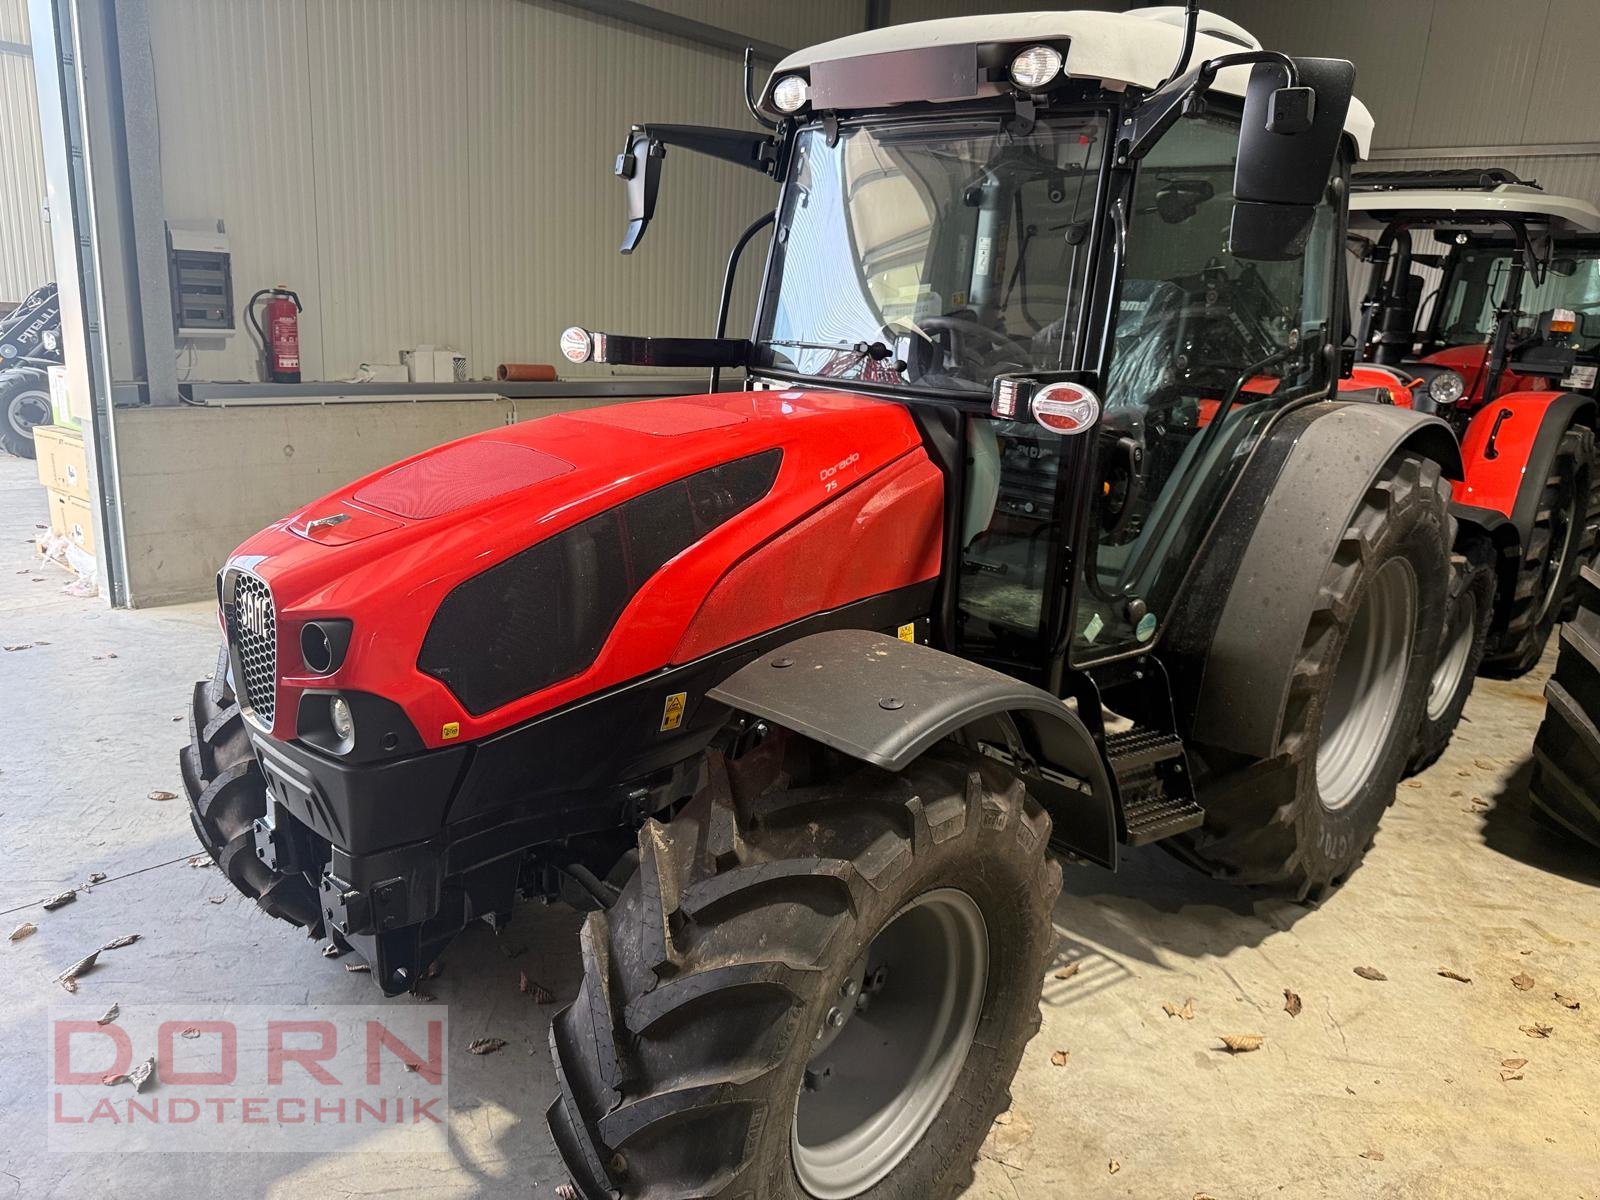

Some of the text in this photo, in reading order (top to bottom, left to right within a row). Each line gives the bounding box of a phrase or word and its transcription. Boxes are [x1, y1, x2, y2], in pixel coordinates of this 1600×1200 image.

[17, 308, 59, 343] PITBULL
[820, 452, 859, 481] Dorado
[825, 480, 838, 493] 75
[241, 591, 268, 639] SAME
